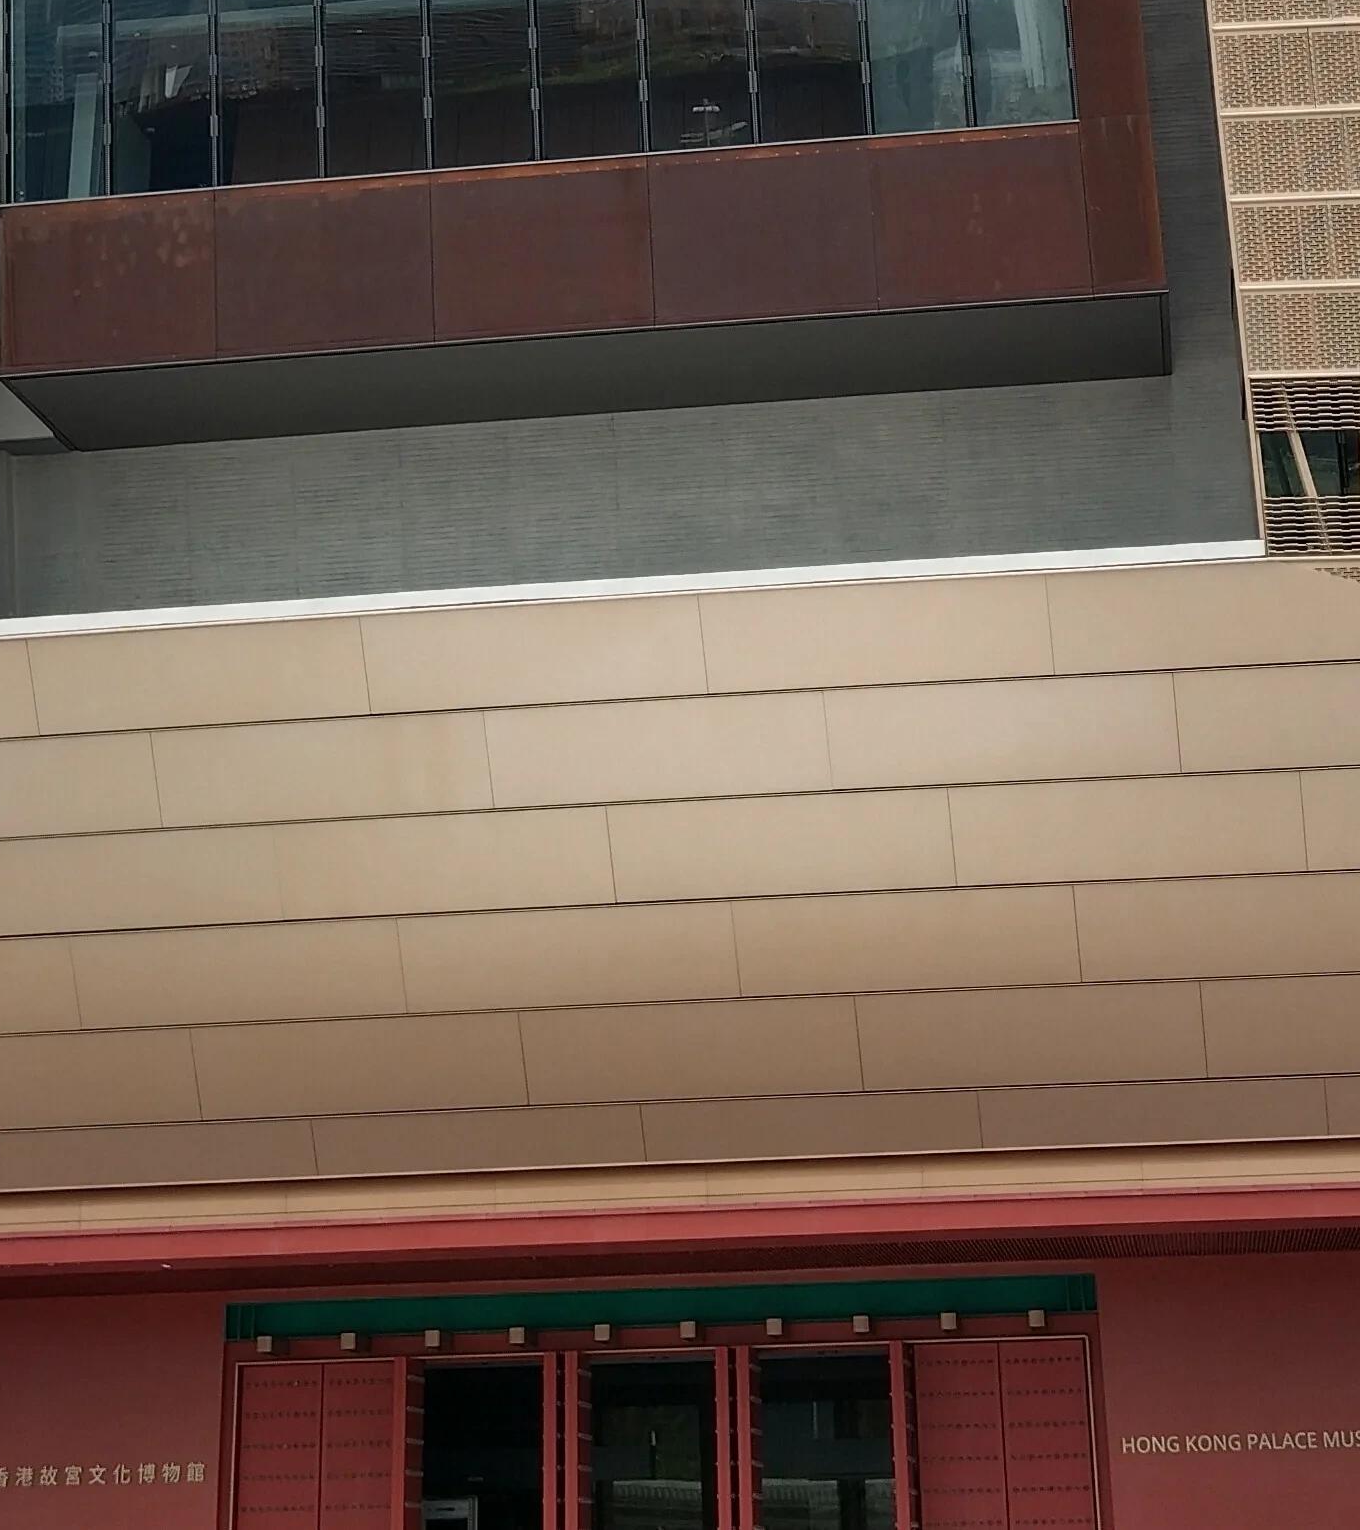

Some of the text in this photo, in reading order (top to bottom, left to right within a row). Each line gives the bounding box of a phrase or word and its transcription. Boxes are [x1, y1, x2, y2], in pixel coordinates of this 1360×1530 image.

[1122, 1436, 1180, 1454] HONG
[1185, 1434, 1241, 1452] KONG
[1247, 1431, 1318, 1450] PALACE
